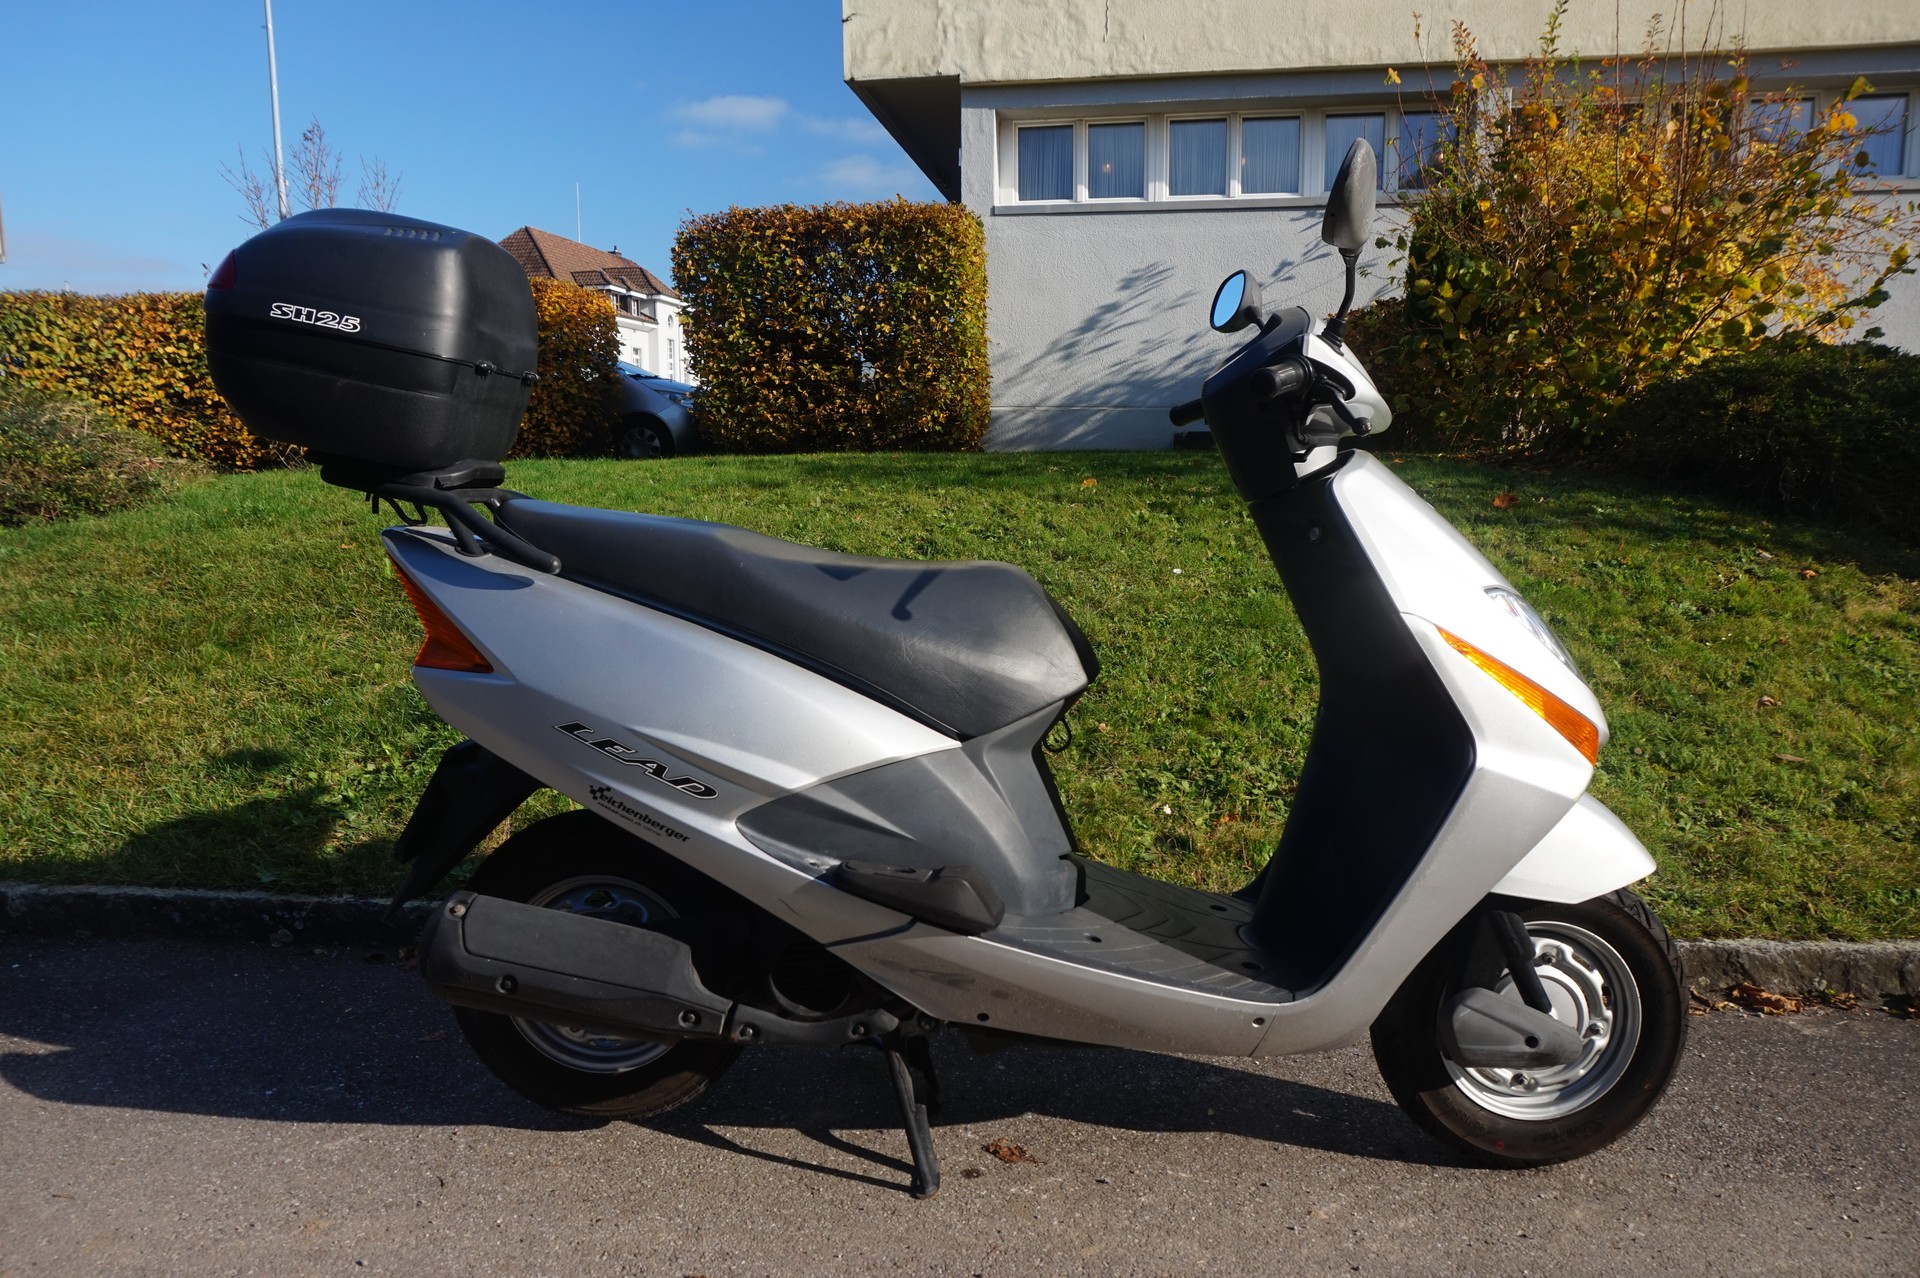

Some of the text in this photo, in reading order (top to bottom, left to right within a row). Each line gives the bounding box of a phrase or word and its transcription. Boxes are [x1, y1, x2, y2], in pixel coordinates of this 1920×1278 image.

[270, 302, 361, 333] SH25
[553, 721, 718, 799] LEAD
[599, 793, 690, 842] eichenberger
